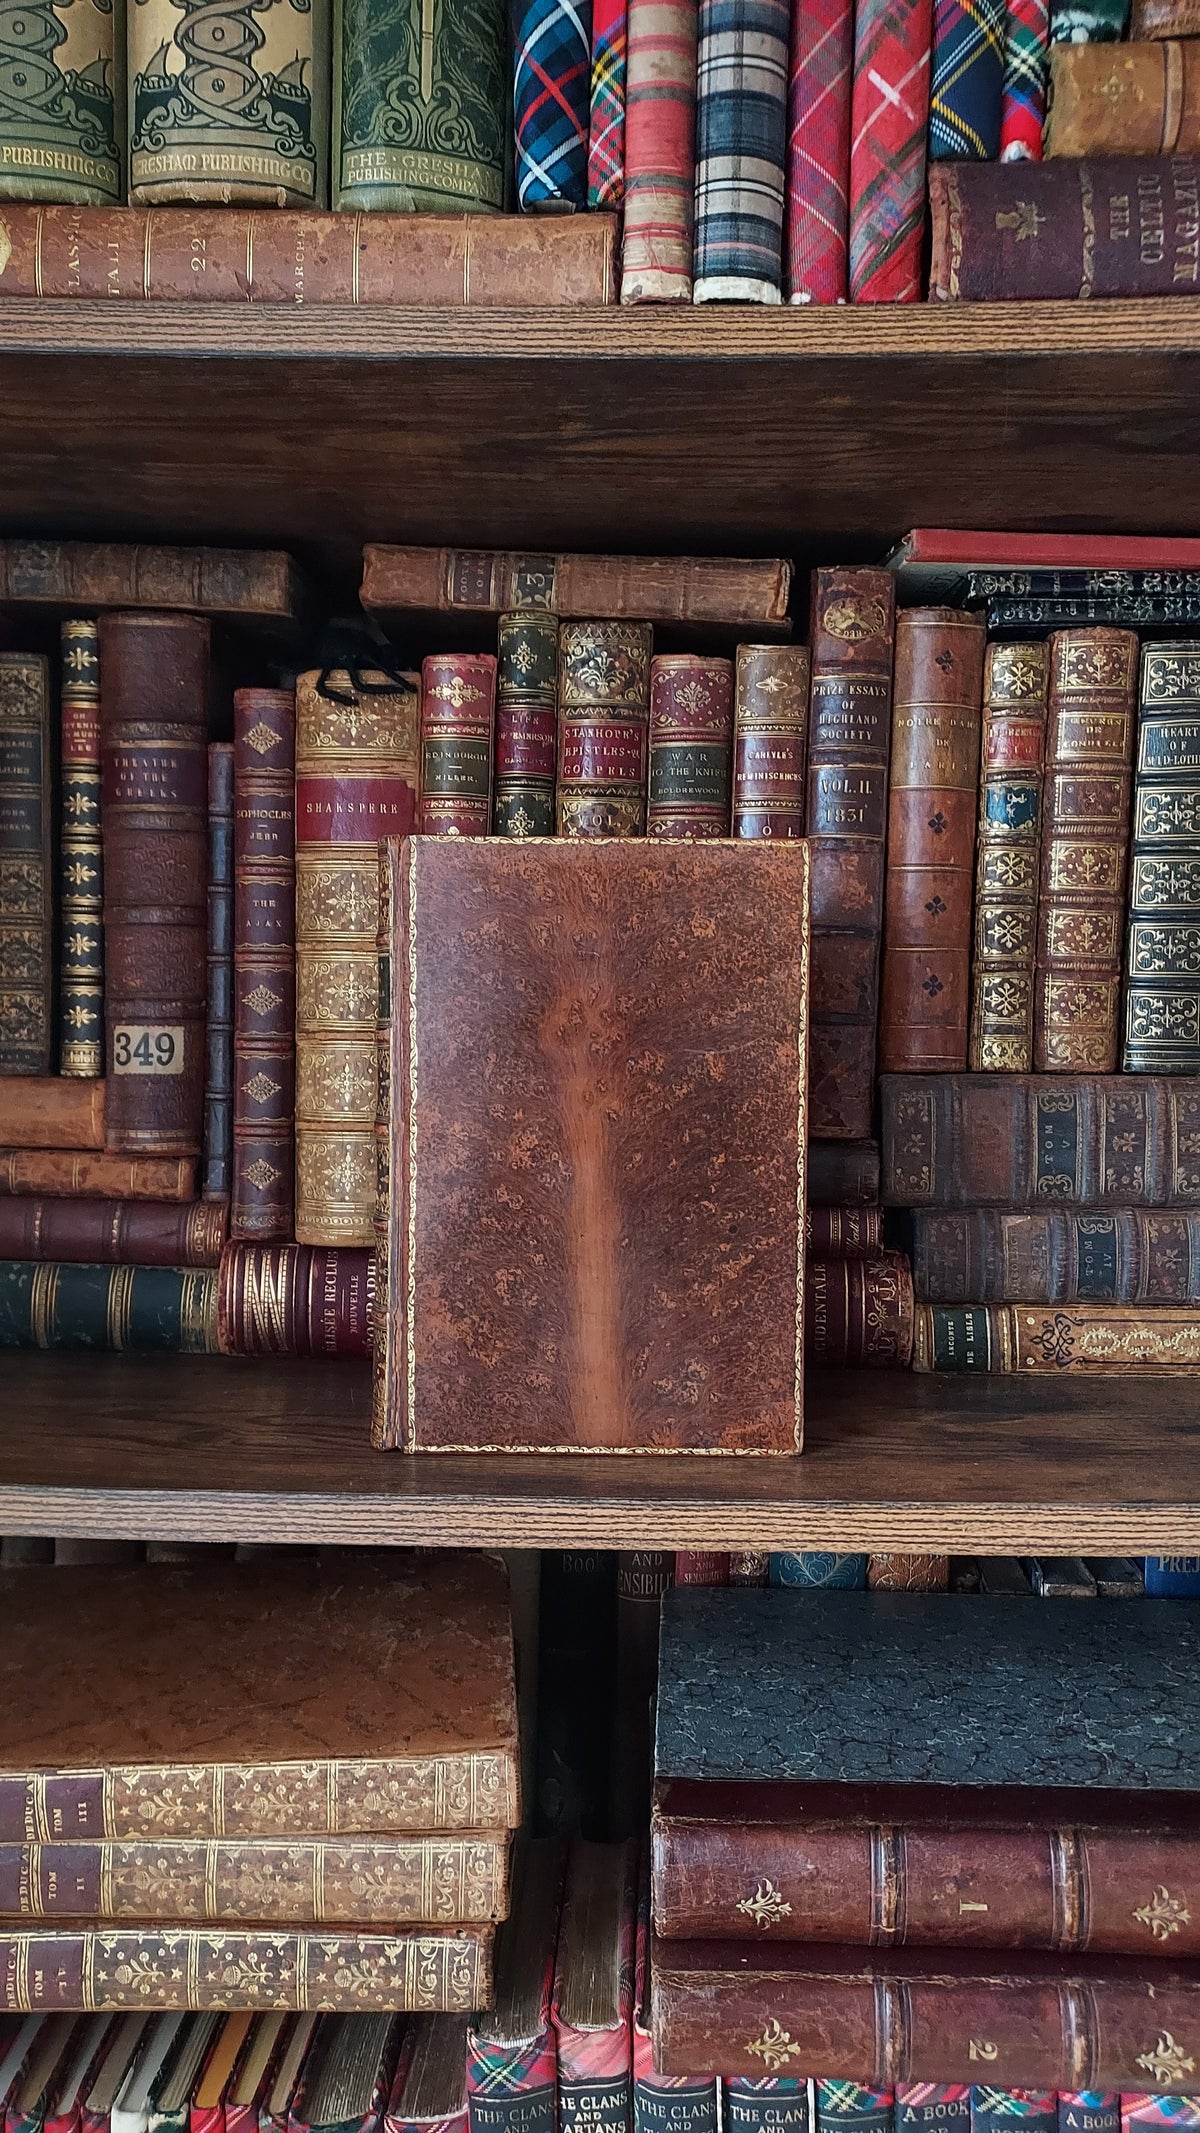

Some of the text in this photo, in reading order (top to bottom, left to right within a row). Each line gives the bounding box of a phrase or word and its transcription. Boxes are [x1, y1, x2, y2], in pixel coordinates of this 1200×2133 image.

[2, 146, 95, 177] PUBLISHING
[201, 153, 291, 178] PUBLISHING
[346, 152, 388, 169] THE
[1109, 195, 1130, 240] THE
[526, 573, 545, 588] 3
[813, 685, 887, 697] PRIZE ESSAYS
[841, 700, 856, 710] OF
[819, 713, 878, 725] HIGHLAND
[821, 729, 873, 741] SOCIETY
[1160, 727, 1199, 739] HEART
[936, 739, 949, 747] DE
[1169, 740, 1187, 751] OF
[113, 758, 178, 769] THEATRE
[671, 752, 708, 761] WAR
[143, 771, 168, 783] THE
[564, 765, 636, 777] GOSPELS
[669, 767, 690, 776] THE
[115, 787, 177, 798] GREEKS
[236, 809, 292, 819] SOPHOCLES
[306, 802, 399, 814] SHAKSPERE
[826, 808, 864, 823] 1831
[252, 899, 276, 908] THE
[246, 919, 282, 928] AJAX
[115, 1033, 175, 1067] 349
[1044, 1124, 1054, 1165] TOM
[1084, 1240, 1094, 1276] TOM
[324, 1250, 339, 1303] RECLUS
[349, 1274, 359, 1335] NOUVELLE
[966, 1312, 974, 1364] DE LISLE
[631, 1552, 663, 1567] AND
[617, 1569, 674, 1596] ENSIBILI
[77, 1801, 87, 1823] III
[53, 1808, 63, 1833] TOM
[48, 1871, 57, 1900] TOM
[76, 1877, 85, 1891] II
[34, 1969, 44, 1999] TOM
[968, 2038, 999, 2062] 2
[560, 2090, 628, 2111] HE CLANS
[639, 2096, 666, 2119] THE
[475, 2107, 504, 2124] THE
[574, 2111, 602, 2122] AND
[730, 2104, 806, 2124] THE CLAN
[902, 2107, 919, 2123] A
[1065, 2112, 1119, 2129] A BOO
[503, 2122, 530, 2133] AND
[560, 2120, 626, 2133] ARTANS
[665, 2121, 692, 2132] AND
